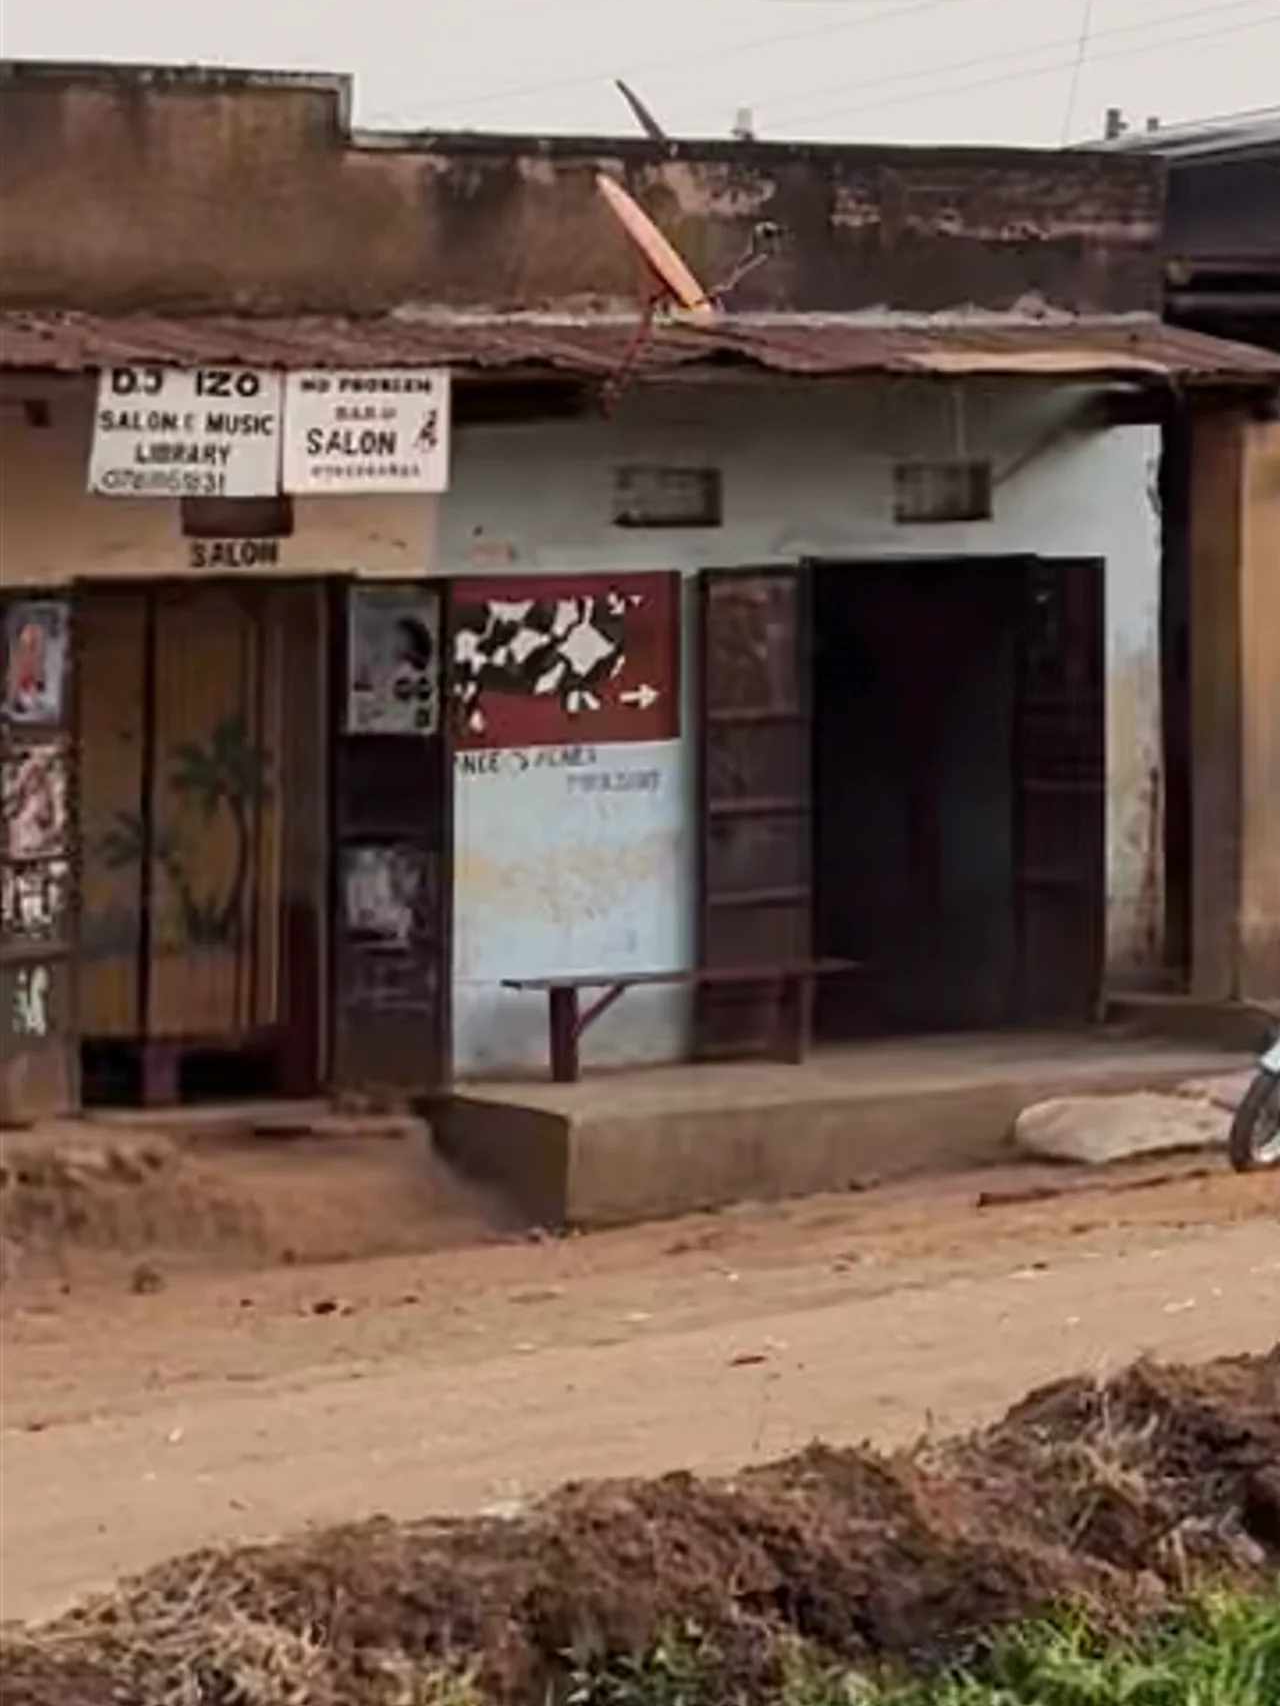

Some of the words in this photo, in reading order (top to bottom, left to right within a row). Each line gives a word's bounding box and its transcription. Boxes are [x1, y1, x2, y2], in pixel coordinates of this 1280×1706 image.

[112, 368, 164, 395] DJ
[196, 371, 260, 397] IZO
[101, 410, 177, 432] SALON
[205, 413, 273, 436] MUSIC
[135, 444, 231, 465] LIBRARY
[306, 428, 397, 456] SALON
[190, 540, 279, 568] SALON
